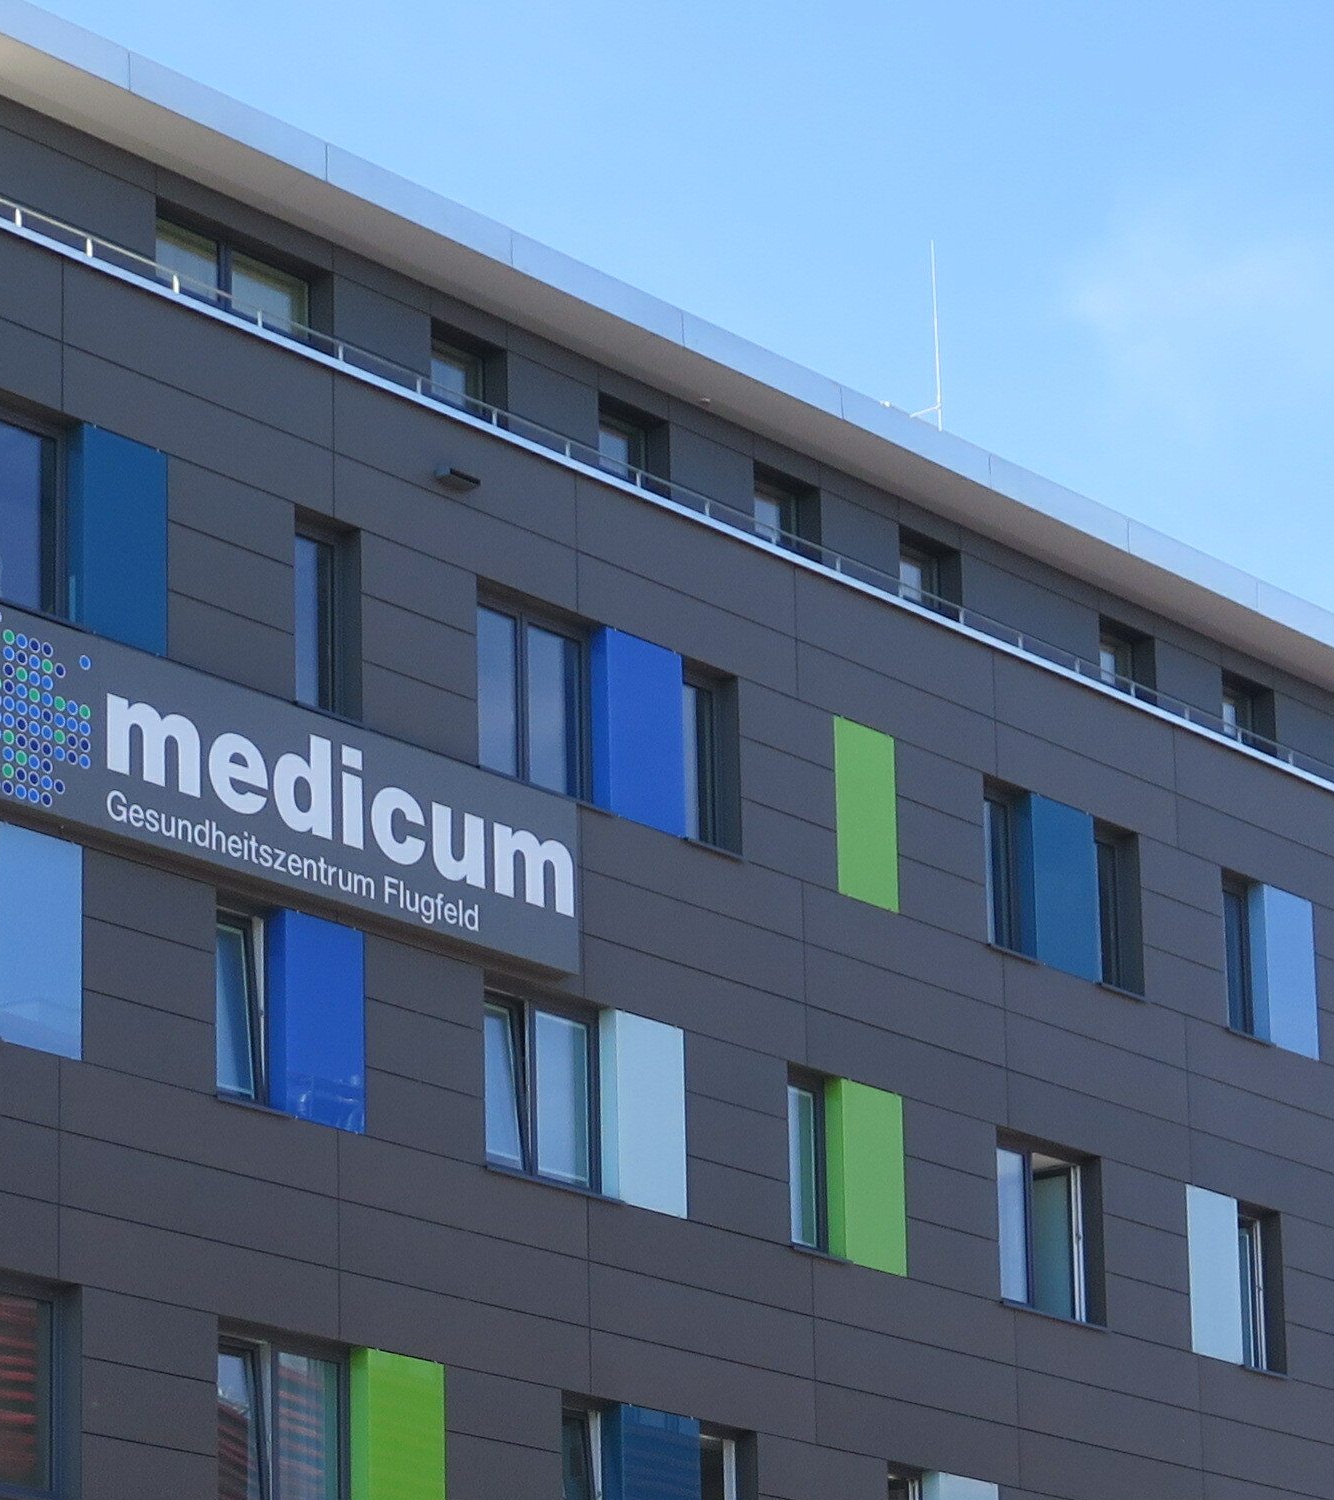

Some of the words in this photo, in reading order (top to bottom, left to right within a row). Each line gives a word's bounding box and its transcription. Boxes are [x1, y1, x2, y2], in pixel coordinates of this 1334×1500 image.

[106, 693, 574, 918] medicum
[106, 789, 375, 900] Gesundheitszentrum
[384, 875, 479, 932] Flugfeld
